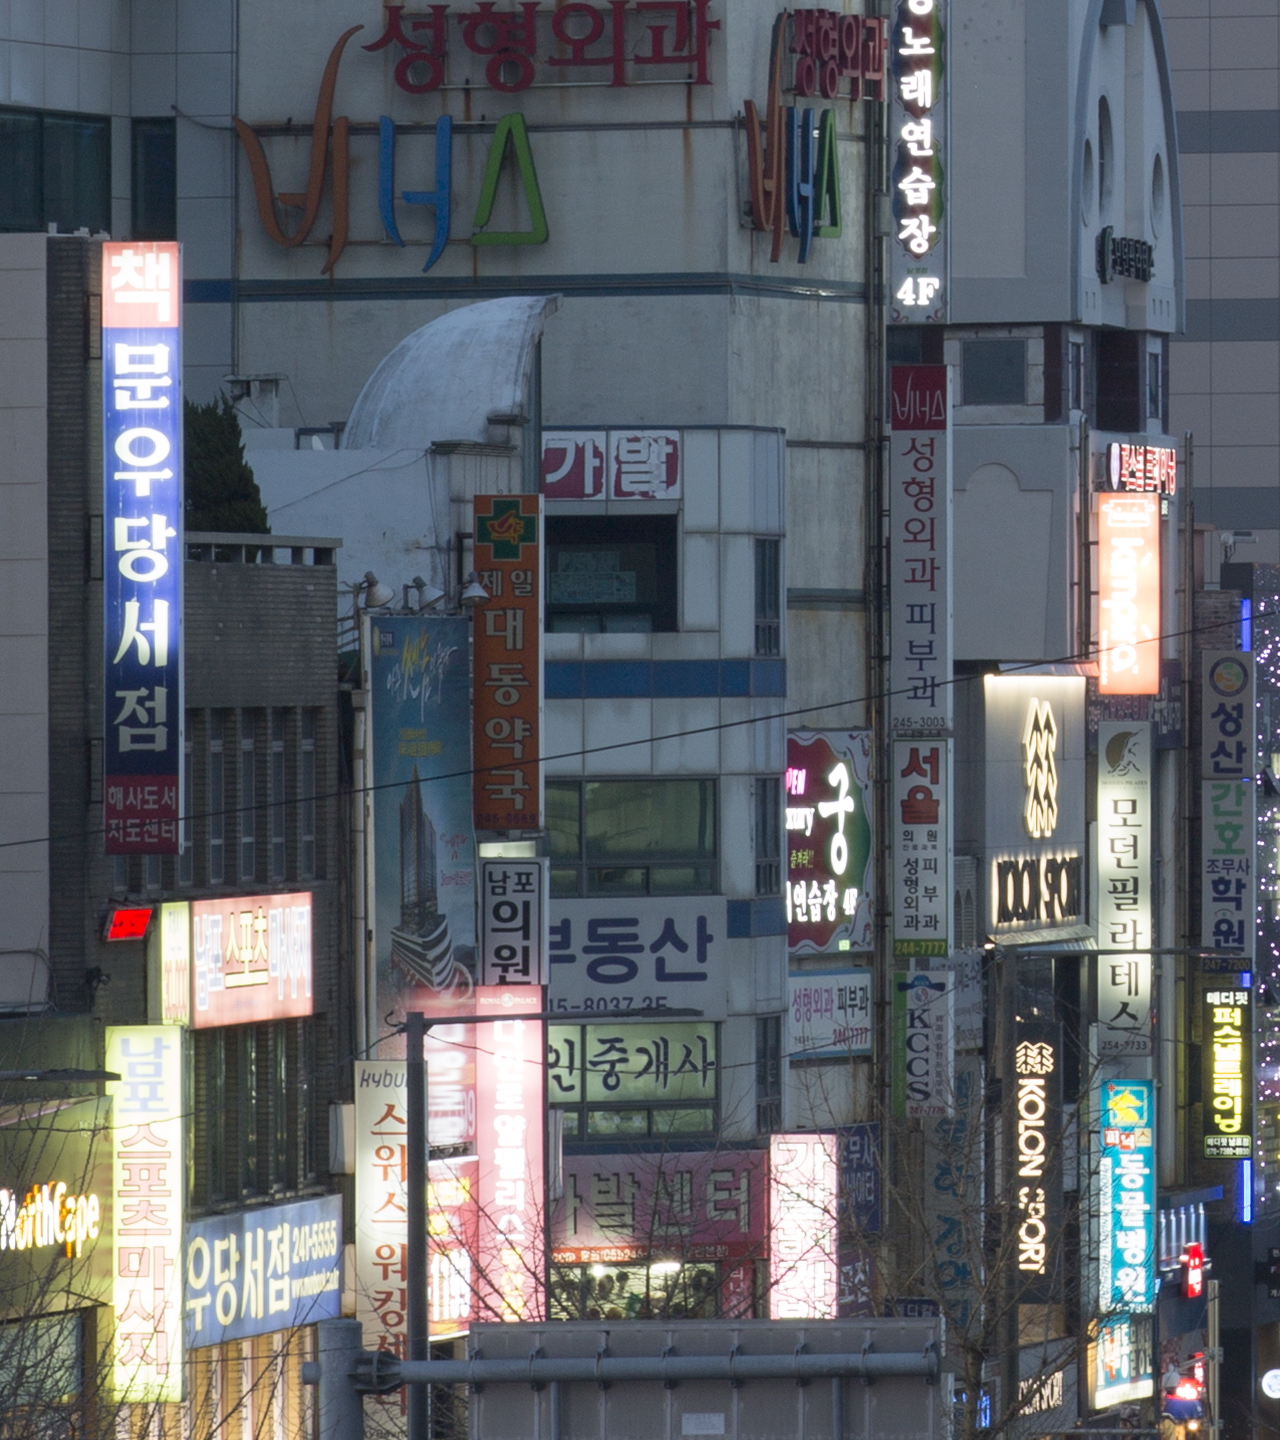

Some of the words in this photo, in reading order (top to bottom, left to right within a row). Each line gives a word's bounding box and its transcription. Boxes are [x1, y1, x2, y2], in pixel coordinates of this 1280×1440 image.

[790, 9, 887, 102] 성형외과
[899, 27, 936, 254] 노래연습장
[111, 249, 170, 322] 책
[897, 277, 940, 306] 4F
[544, 435, 681, 499] 가발
[113, 342, 176, 752] 문우당서점
[902, 437, 940, 593] 성형외과
[480, 568, 534, 598] 제일
[905, 603, 938, 709] 피부과
[484, 608, 532, 811] 대동약국
[892, 716, 947, 728] 245-3003
[1210, 702, 1246, 775] 성산
[108, 783, 176, 810] 해사도서
[108, 816, 177, 844] 지도센터
[818, 762, 855, 876] 궁
[1210, 783, 1246, 855] 간호
[903, 829, 938, 842] 의원
[1206, 859, 1251, 875] 조무사
[487, 870, 536, 896] 남포
[903, 857, 921, 932] 성형외과
[922, 858, 939, 931] 피부과
[1105, 798, 1143, 1032] 모던필라테스
[1211, 876, 1246, 951] 학원
[491, 899, 532, 986] 의원
[894, 940, 946, 955] 244-7777
[1204, 959, 1250, 970] 247-7200
[791, 986, 834, 1023] 성형외과
[837, 984, 869, 1019] 피부과
[1206, 991, 1249, 1005] 메디핏
[906, 1008, 932, 1102] KCCS
[1212, 1006, 1243, 1133] 퍼스널트레이닝
[370, 1103, 408, 1223] 스위스
[1017, 1078, 1046, 1177] KOLON
[1114, 1153, 1150, 1305] 동물병원
